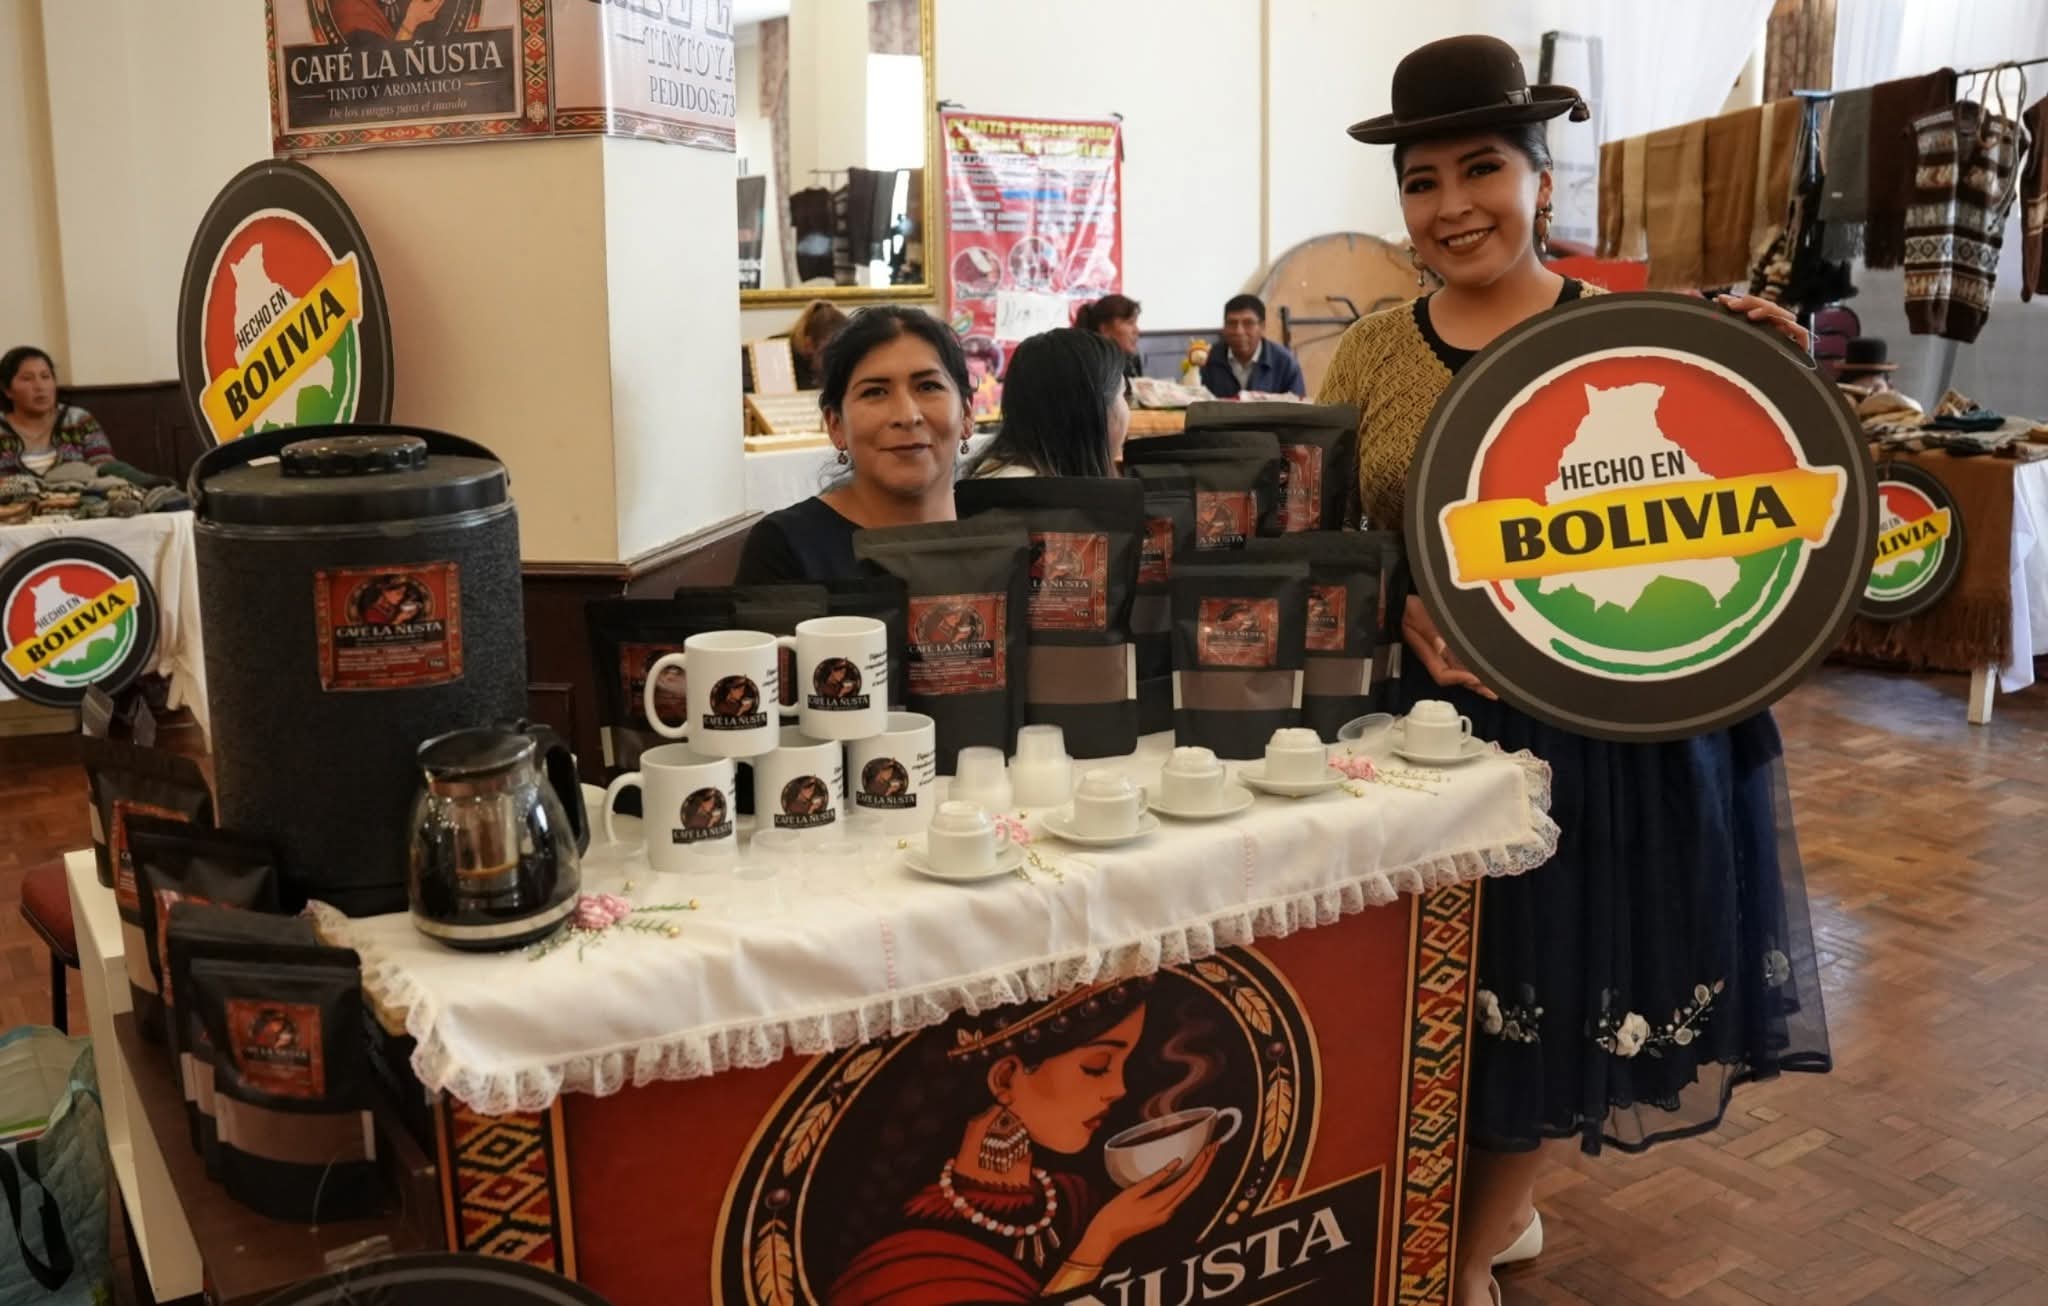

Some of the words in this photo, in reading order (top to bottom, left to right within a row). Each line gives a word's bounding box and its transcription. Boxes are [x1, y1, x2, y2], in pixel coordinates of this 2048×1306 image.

[291, 47, 354, 86] CAFÉ
[361, 50, 399, 80] LA
[404, 40, 505, 77] ÑUSTA
[327, 87, 369, 102] TINTO
[371, 86, 380, 98] Y
[383, 78, 462, 97] AROMÁTICO
[329, 107, 343, 120] De
[344, 105, 358, 118] los
[396, 103, 420, 115] para
[236, 305, 272, 352] HECHO
[271, 288, 288, 316] EN
[224, 287, 346, 421] BOLIVIA
[1560, 455, 1645, 491] HECHO
[1651, 450, 1685, 478] EN
[1500, 485, 1797, 563] BOLIVIA
[1878, 520, 1939, 556] LIVIA
[26, 592, 126, 663] BOLIVIA
[36, 604, 67, 630] HECHO
[69, 597, 81, 611] EN
[372, 625, 393, 637] LA
